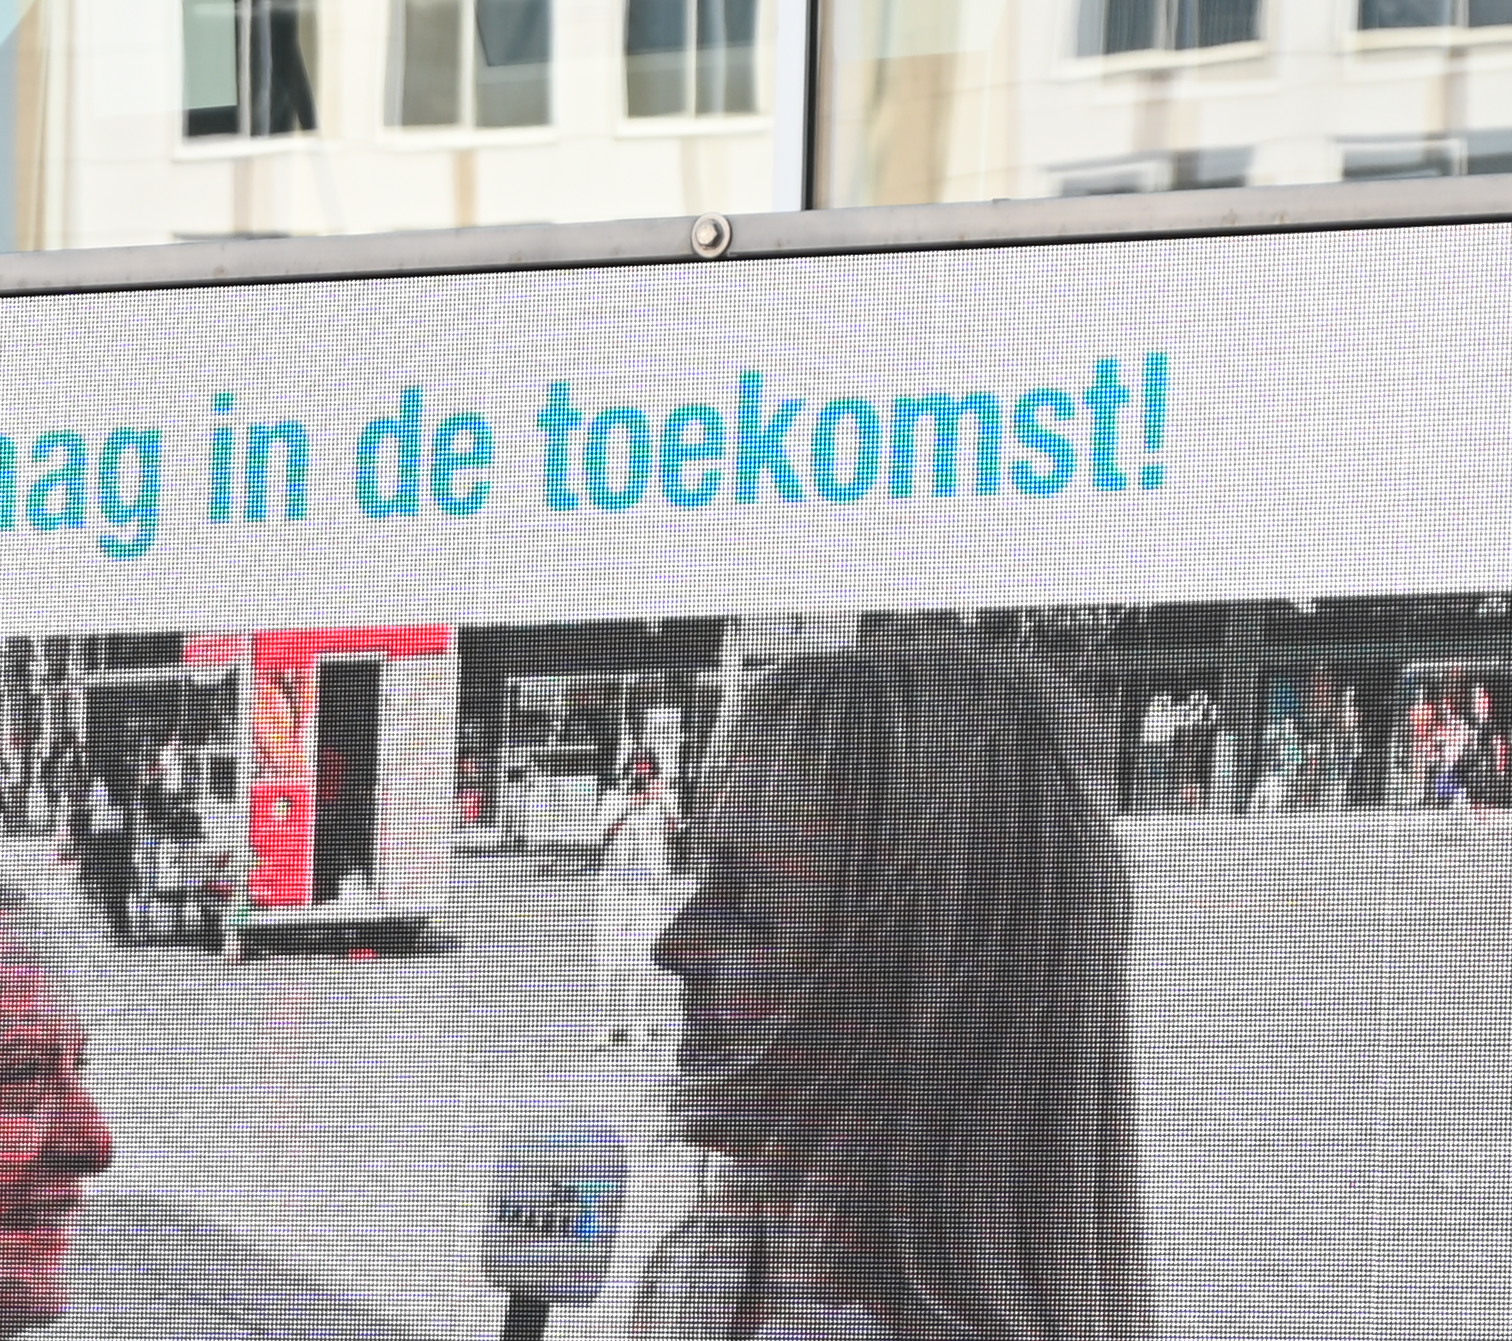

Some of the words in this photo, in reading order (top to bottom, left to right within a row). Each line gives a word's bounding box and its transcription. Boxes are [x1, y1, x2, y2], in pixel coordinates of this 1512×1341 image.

[207, 391, 311, 522] in
[355, 386, 494, 516] de
[537, 351, 1170, 513] toekomst!
